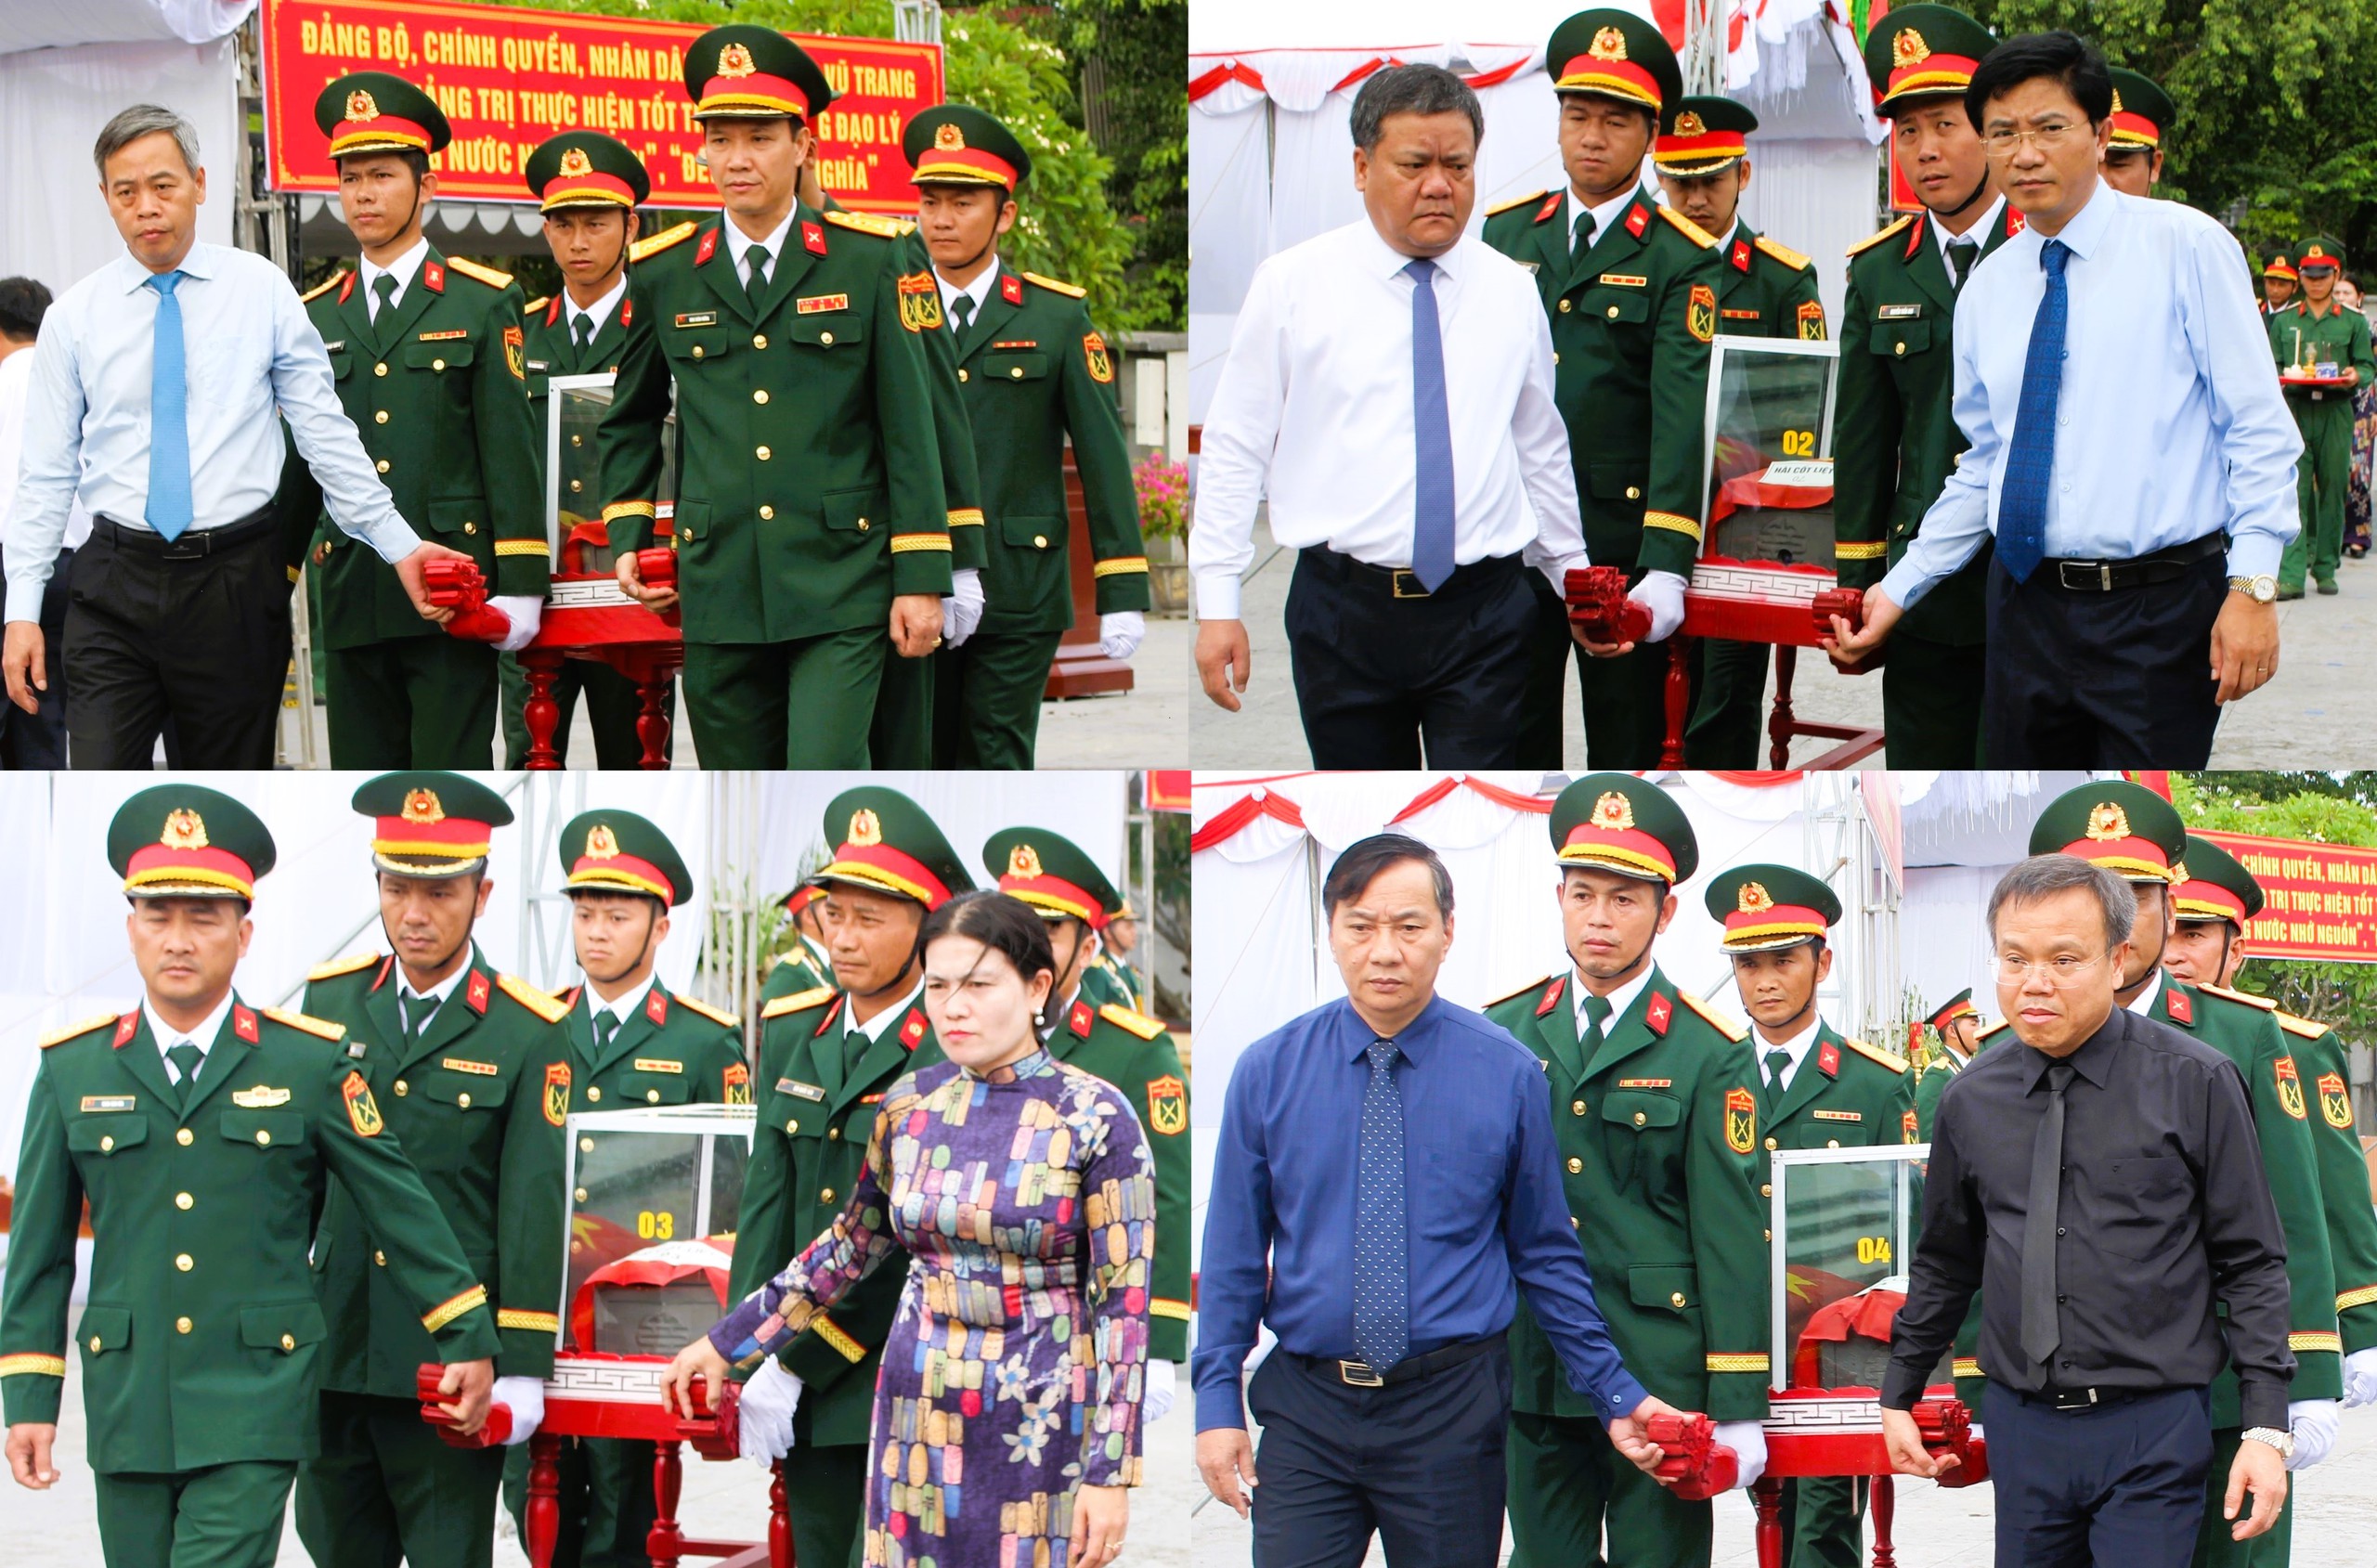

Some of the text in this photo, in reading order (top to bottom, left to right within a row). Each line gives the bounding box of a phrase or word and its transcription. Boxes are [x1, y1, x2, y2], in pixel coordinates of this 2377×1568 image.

[302, 12, 916, 99] ĐẢNG BỘ, CHÍNH QUYỀN, NHÂN DÂ VŨ TRANG
[477, 88, 514, 128] TRỊ
[519, 91, 578, 132] THỰC
[582, 91, 634, 136] HIỆN
[639, 90, 676, 132] TỐT
[836, 112, 875, 149] ĐẠO
[448, 135, 513, 174] NƯỚC
[1783, 430, 1814, 456] 02
[2241, 851, 2280, 877] CHÍNH
[2328, 860, 2359, 885] NHÂN
[2268, 888, 2290, 914] TRỊ
[2291, 890, 2322, 916] THỰC
[2323, 890, 2352, 918] HIỆN
[2353, 889, 2374, 916] TỐT
[2254, 917, 2288, 942] NƯỚC
[2290, 919, 2315, 943] NHỚ
[638, 1211, 673, 1239] 03
[1857, 1237, 1892, 1264] 04
